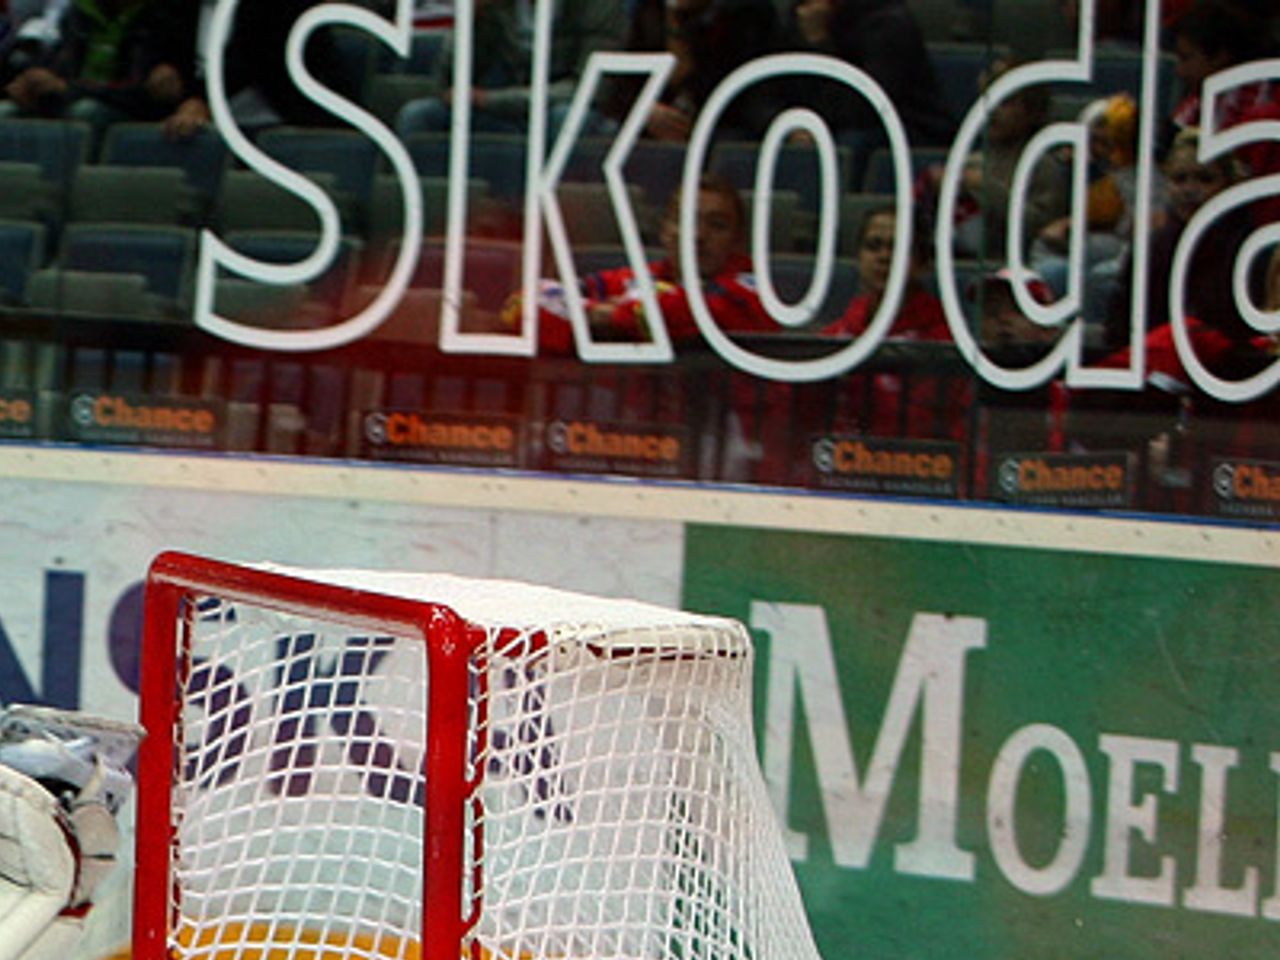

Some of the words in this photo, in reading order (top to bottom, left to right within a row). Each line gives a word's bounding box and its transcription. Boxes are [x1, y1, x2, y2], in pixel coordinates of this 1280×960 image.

[95, 394, 214, 432] Chance
[386, 411, 514, 450] Chance
[568, 421, 680, 460] Chance
[833, 440, 953, 479] Chance
[1017, 457, 1124, 492] Chance
